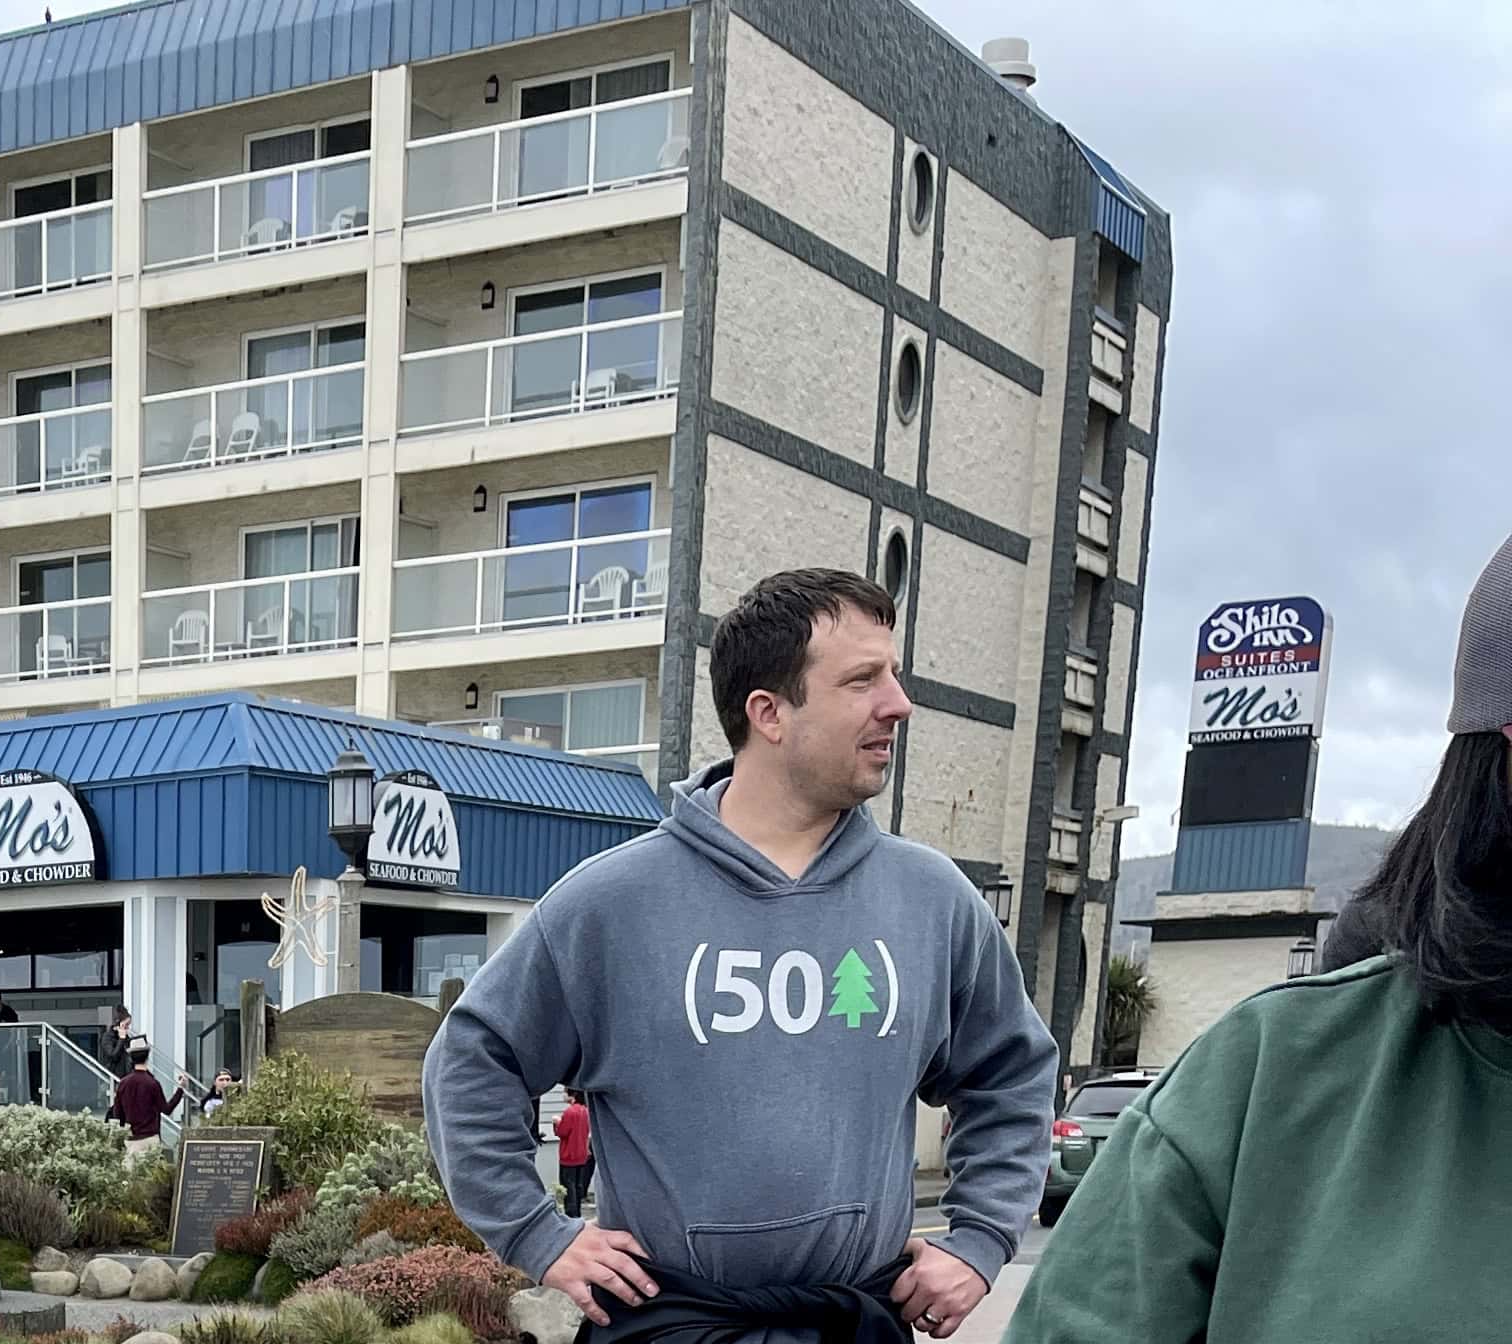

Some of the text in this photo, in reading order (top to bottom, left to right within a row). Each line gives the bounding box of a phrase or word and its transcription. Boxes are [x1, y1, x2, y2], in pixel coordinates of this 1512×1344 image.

[1208, 603, 1313, 653] Shilo
[1221, 650, 1296, 667] SUITES
[1203, 661, 1311, 680] OCEANFRONT
[1203, 685, 1301, 727] Mo's
[1190, 726, 1309, 744] SEAFOOD & CHOWDER
[384, 791, 449, 860] Mo's
[12, 870, 22, 882] &
[24, 864, 91, 881] CHOWDER
[369, 863, 458, 885] SEAFOOD & CHOWDER
